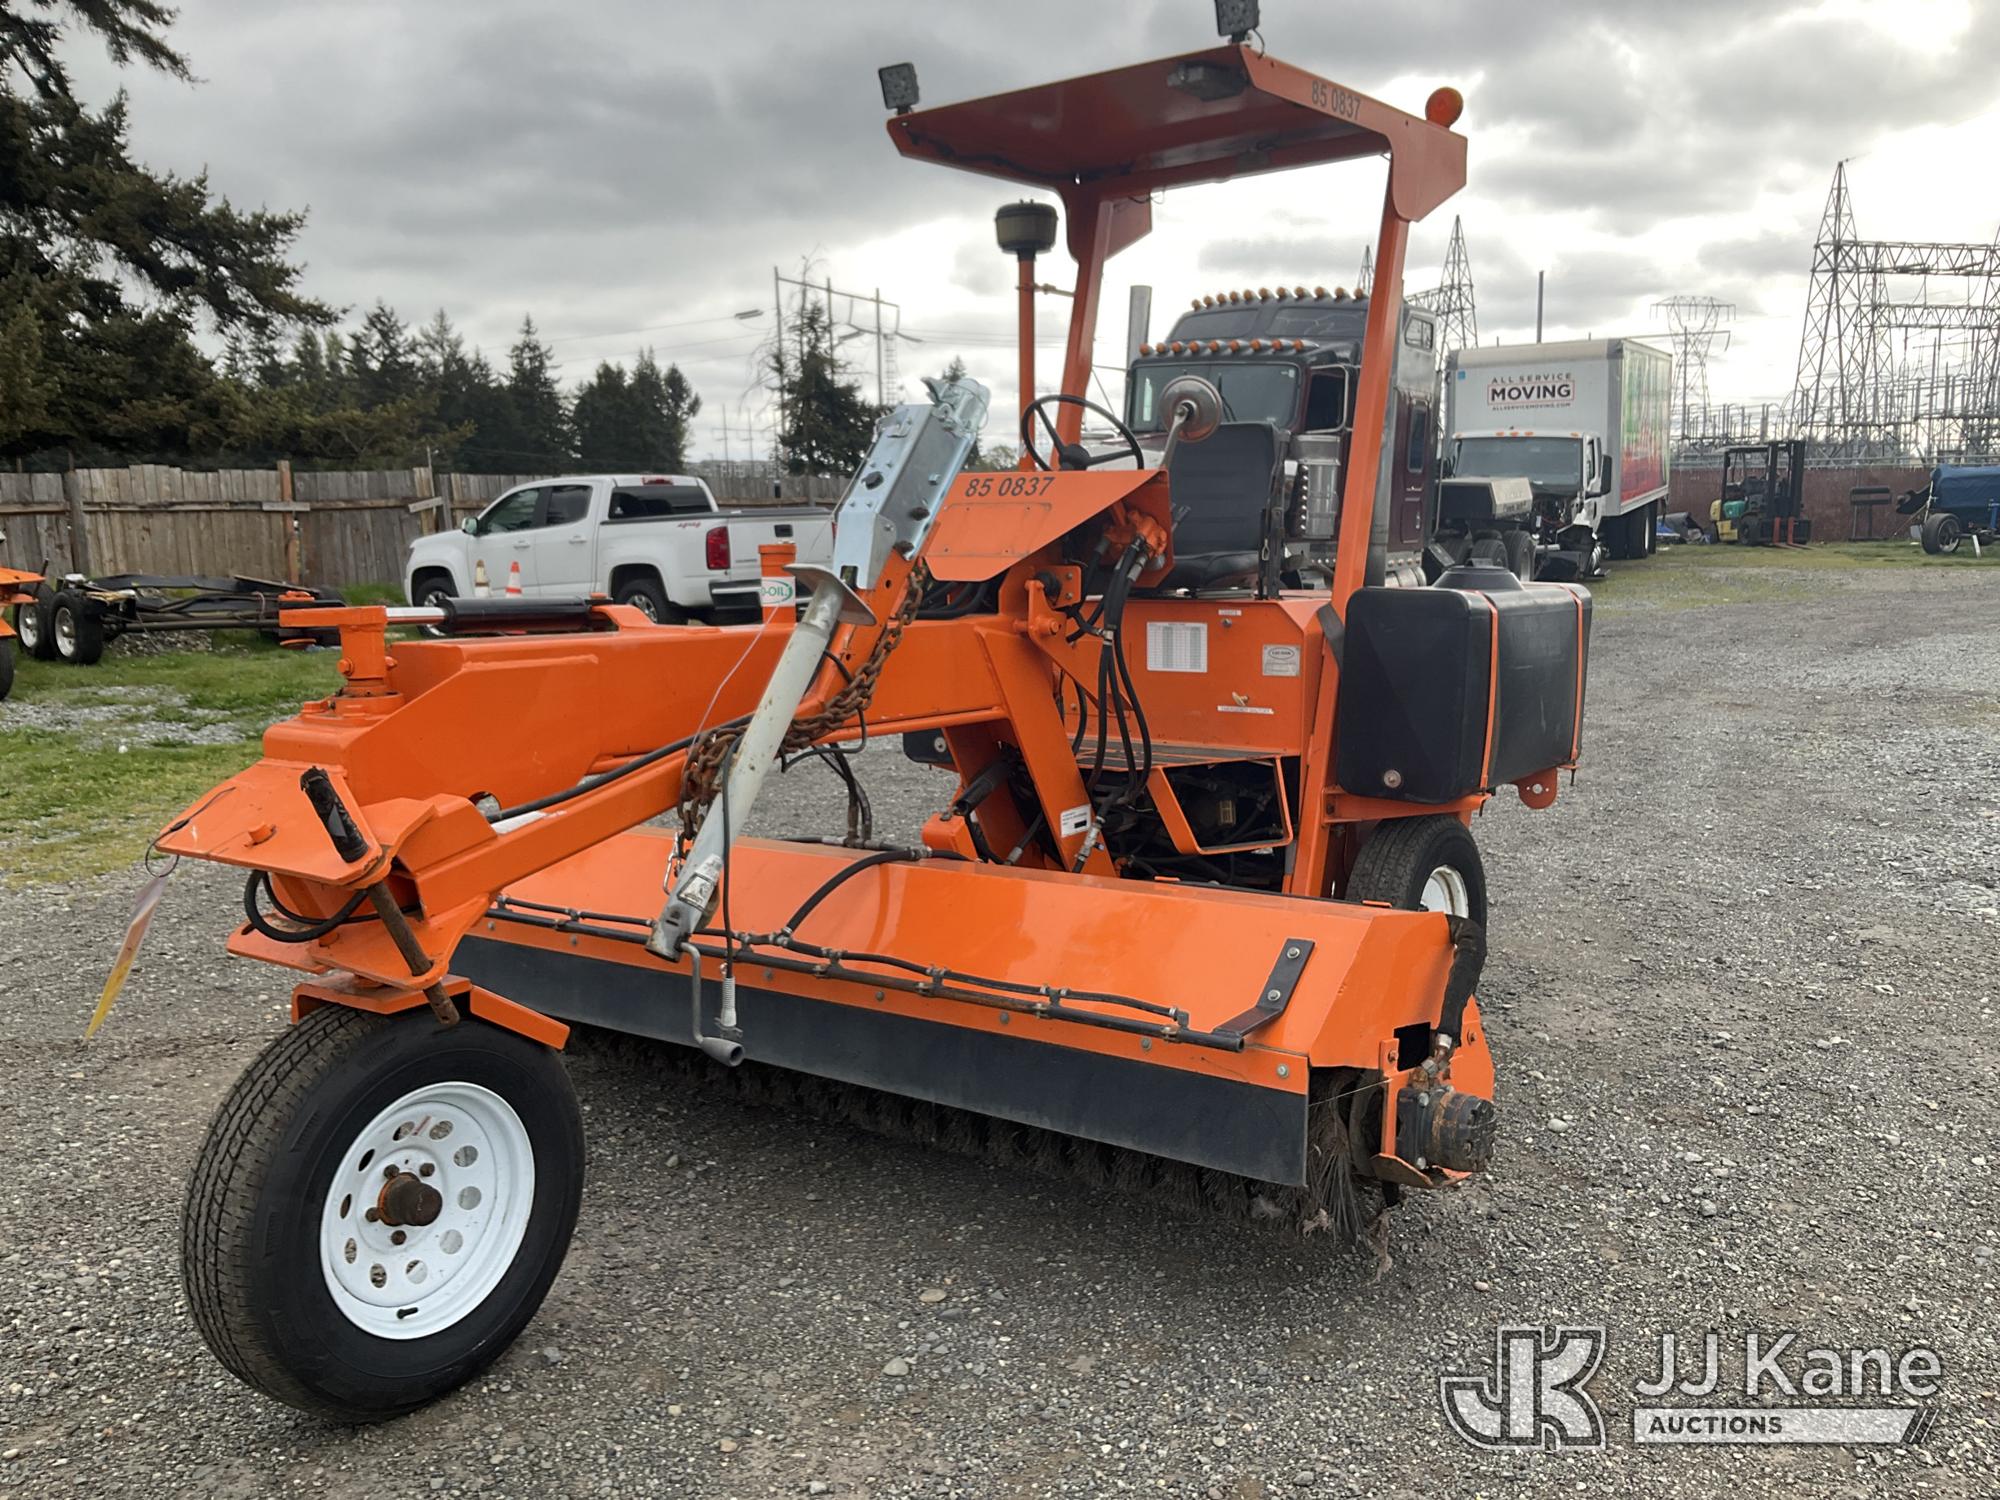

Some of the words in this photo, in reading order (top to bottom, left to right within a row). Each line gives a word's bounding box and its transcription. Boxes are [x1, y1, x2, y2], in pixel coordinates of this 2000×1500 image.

[1311, 80, 1327, 107] 85
[1331, 88, 1361, 121] 0837
[1519, 373, 1571, 382] SERVICE
[1491, 384, 1571, 401] MOVING
[964, 478, 993, 498] 85
[998, 476, 1055, 497] 0837
